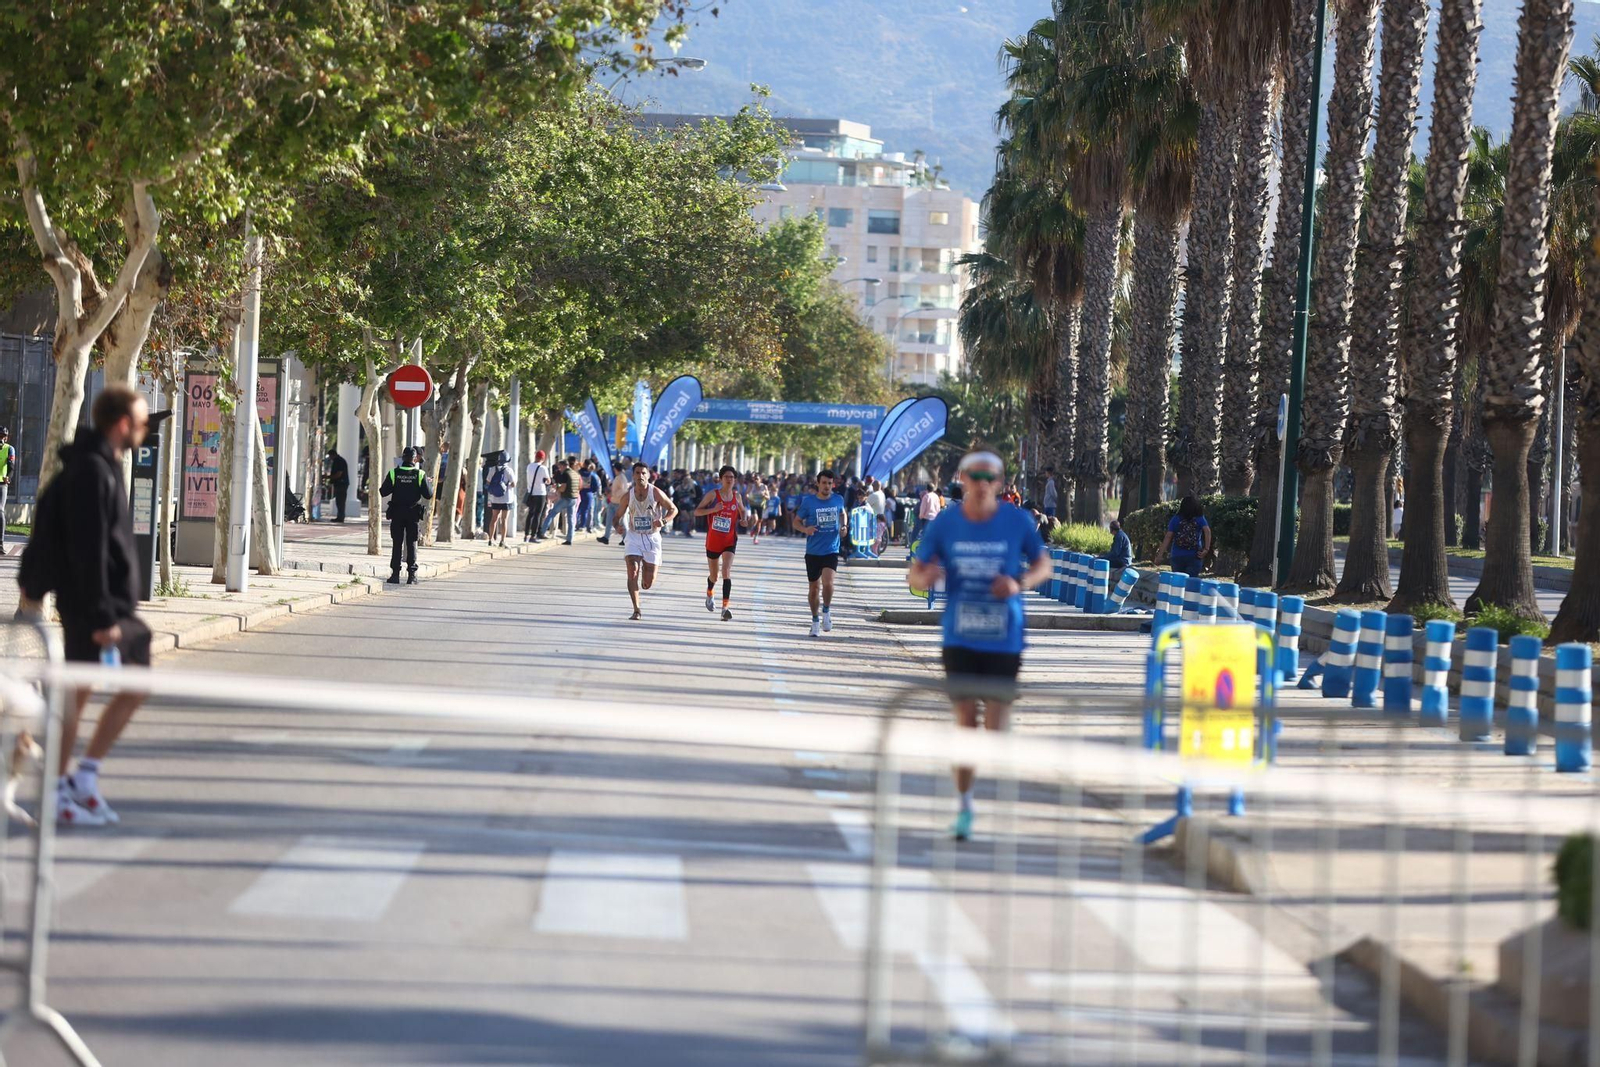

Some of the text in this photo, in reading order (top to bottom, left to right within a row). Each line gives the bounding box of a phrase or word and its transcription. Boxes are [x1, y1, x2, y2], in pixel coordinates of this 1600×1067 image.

[191, 384, 212, 400] 06
[650, 390, 690, 446] mayoral
[827, 408, 877, 420] mayoral
[881, 411, 935, 463] mayoral
[138, 446, 151, 463] P
